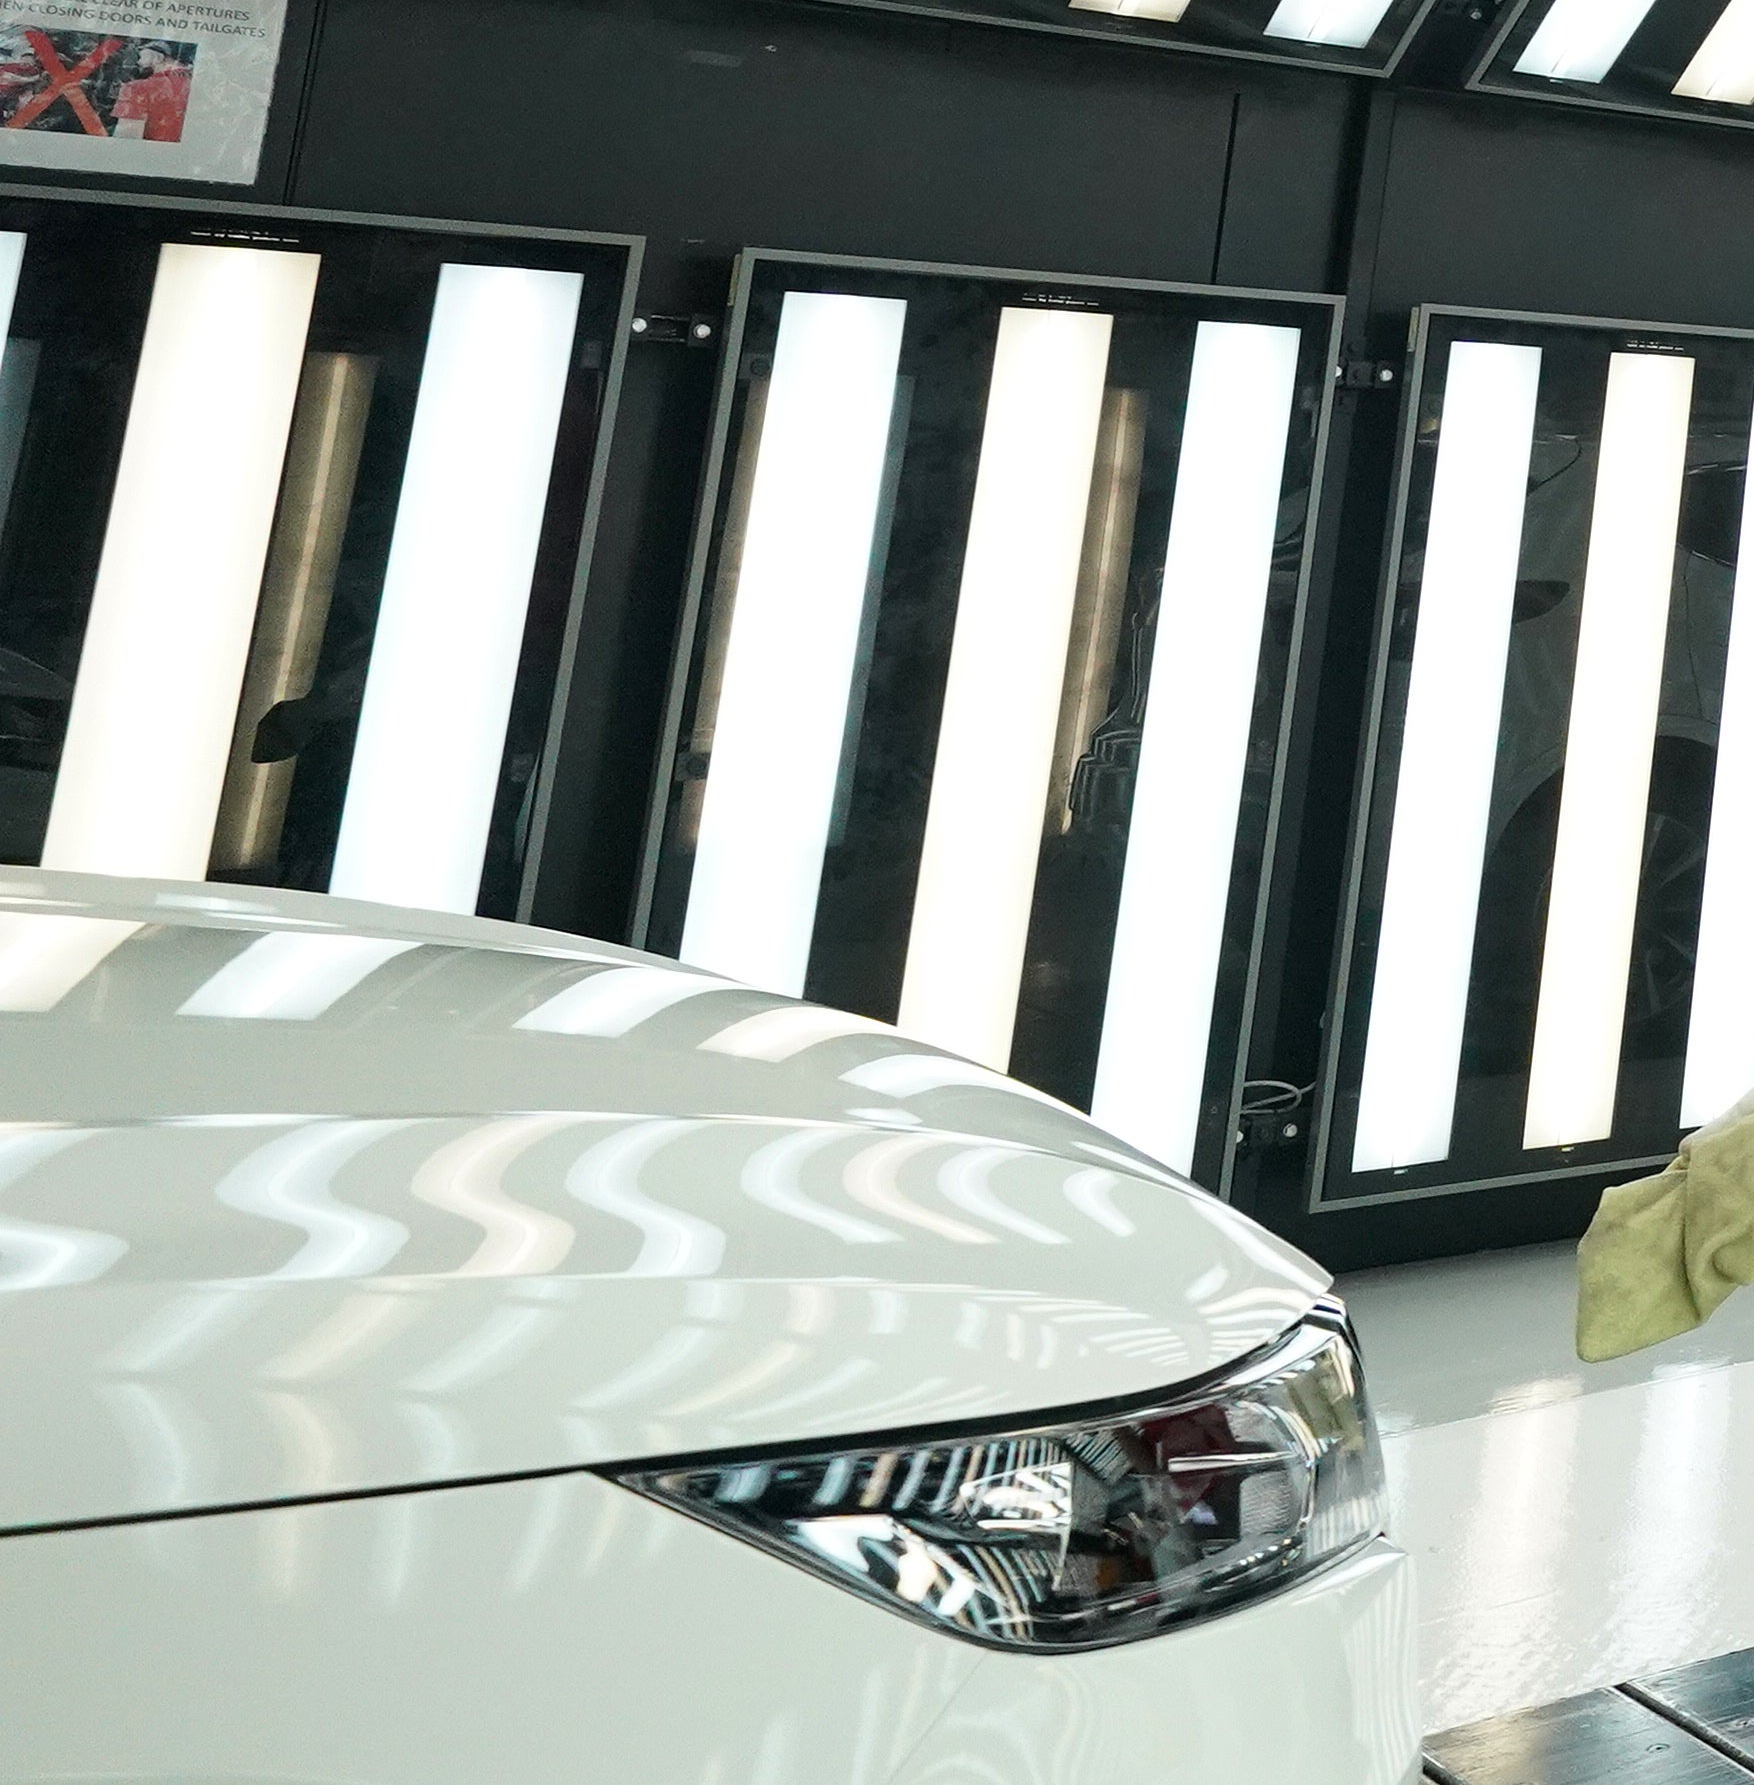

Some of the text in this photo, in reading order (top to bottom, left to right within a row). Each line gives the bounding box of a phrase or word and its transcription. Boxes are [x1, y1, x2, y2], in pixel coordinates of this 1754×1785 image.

[0, 0, 267, 38] EN CLOSING DOORS AND TAILGATES
[142, 0, 163, 10] OF
[166, 3, 251, 21] APERTURES
